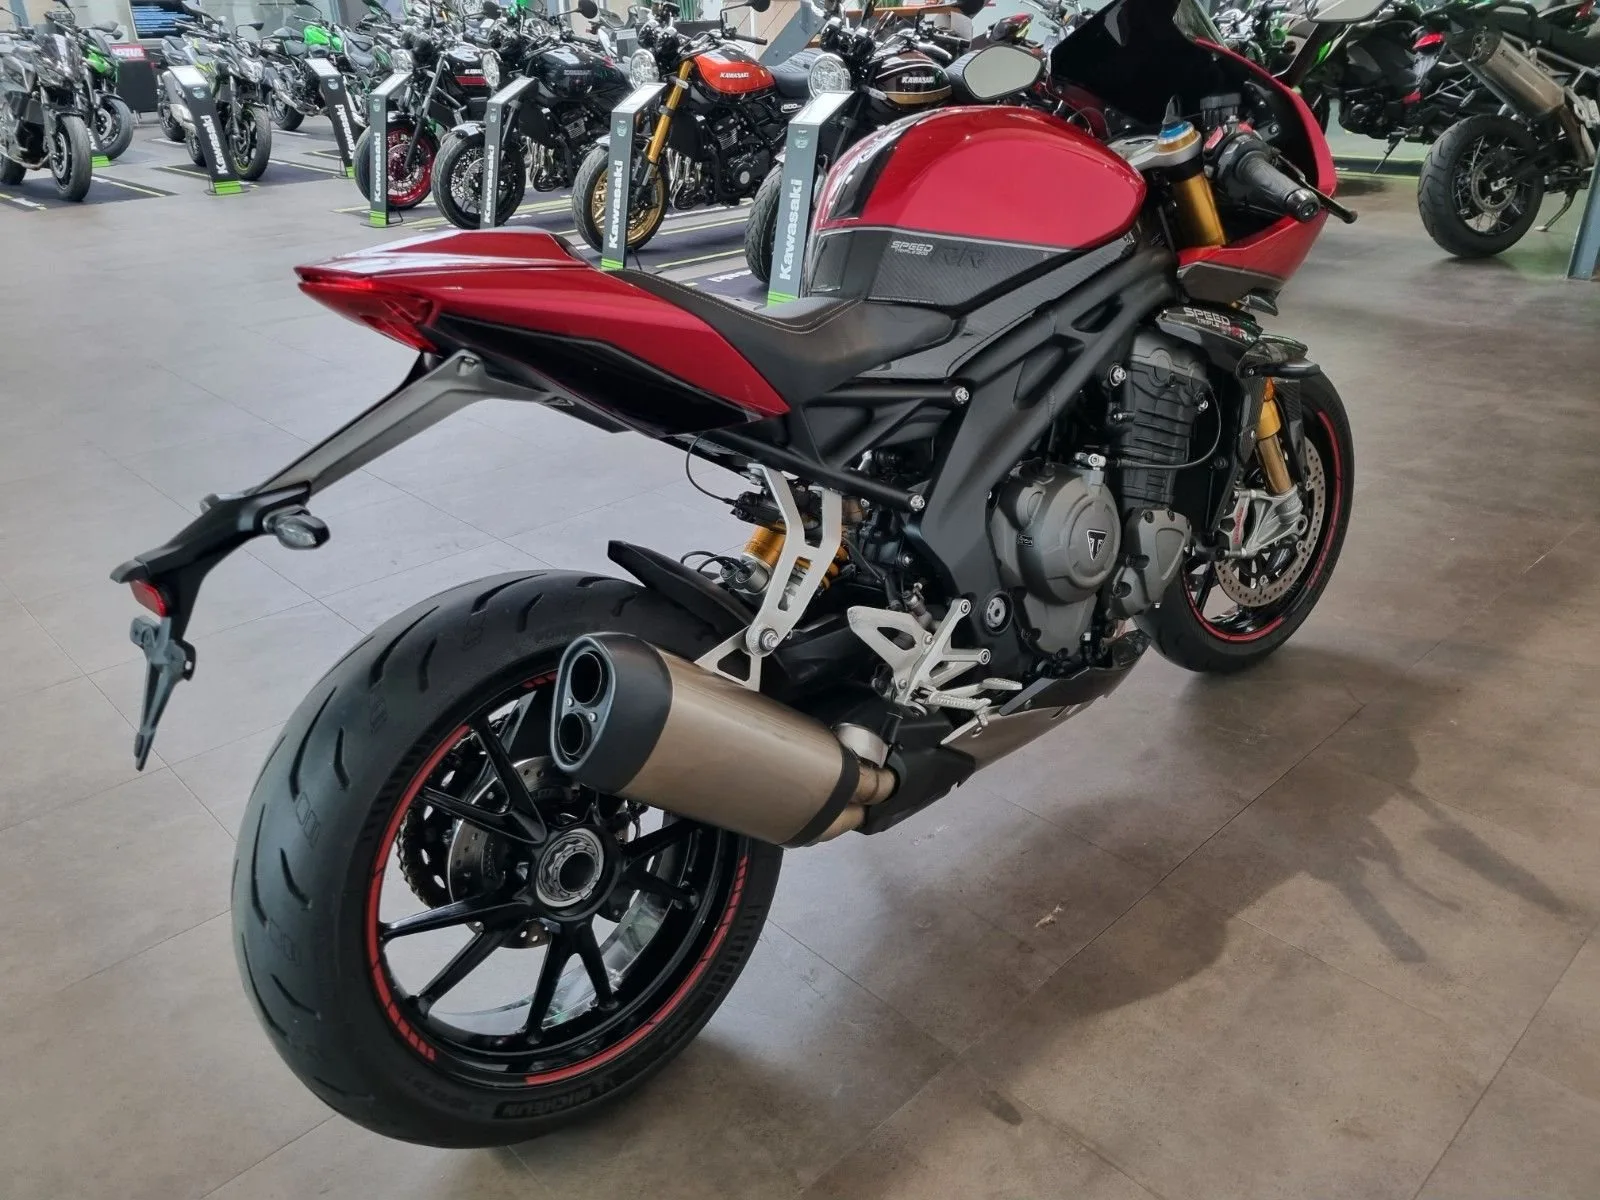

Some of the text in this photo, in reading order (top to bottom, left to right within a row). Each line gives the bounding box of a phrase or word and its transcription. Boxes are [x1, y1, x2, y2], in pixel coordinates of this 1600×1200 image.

[720, 71, 749, 79] KAWASAKI
[901, 76, 935, 84] KAWASAKI
[200, 114, 229, 175] Kawasaki
[374, 132, 382, 202] Kawasaki
[484, 145, 495, 224] Kawasaki
[609, 160, 624, 249] Kawasaki
[779, 179, 803, 281] Kawasaki
[890, 240, 934, 253] SPEED
[1183, 306, 1231, 326] SPEED
